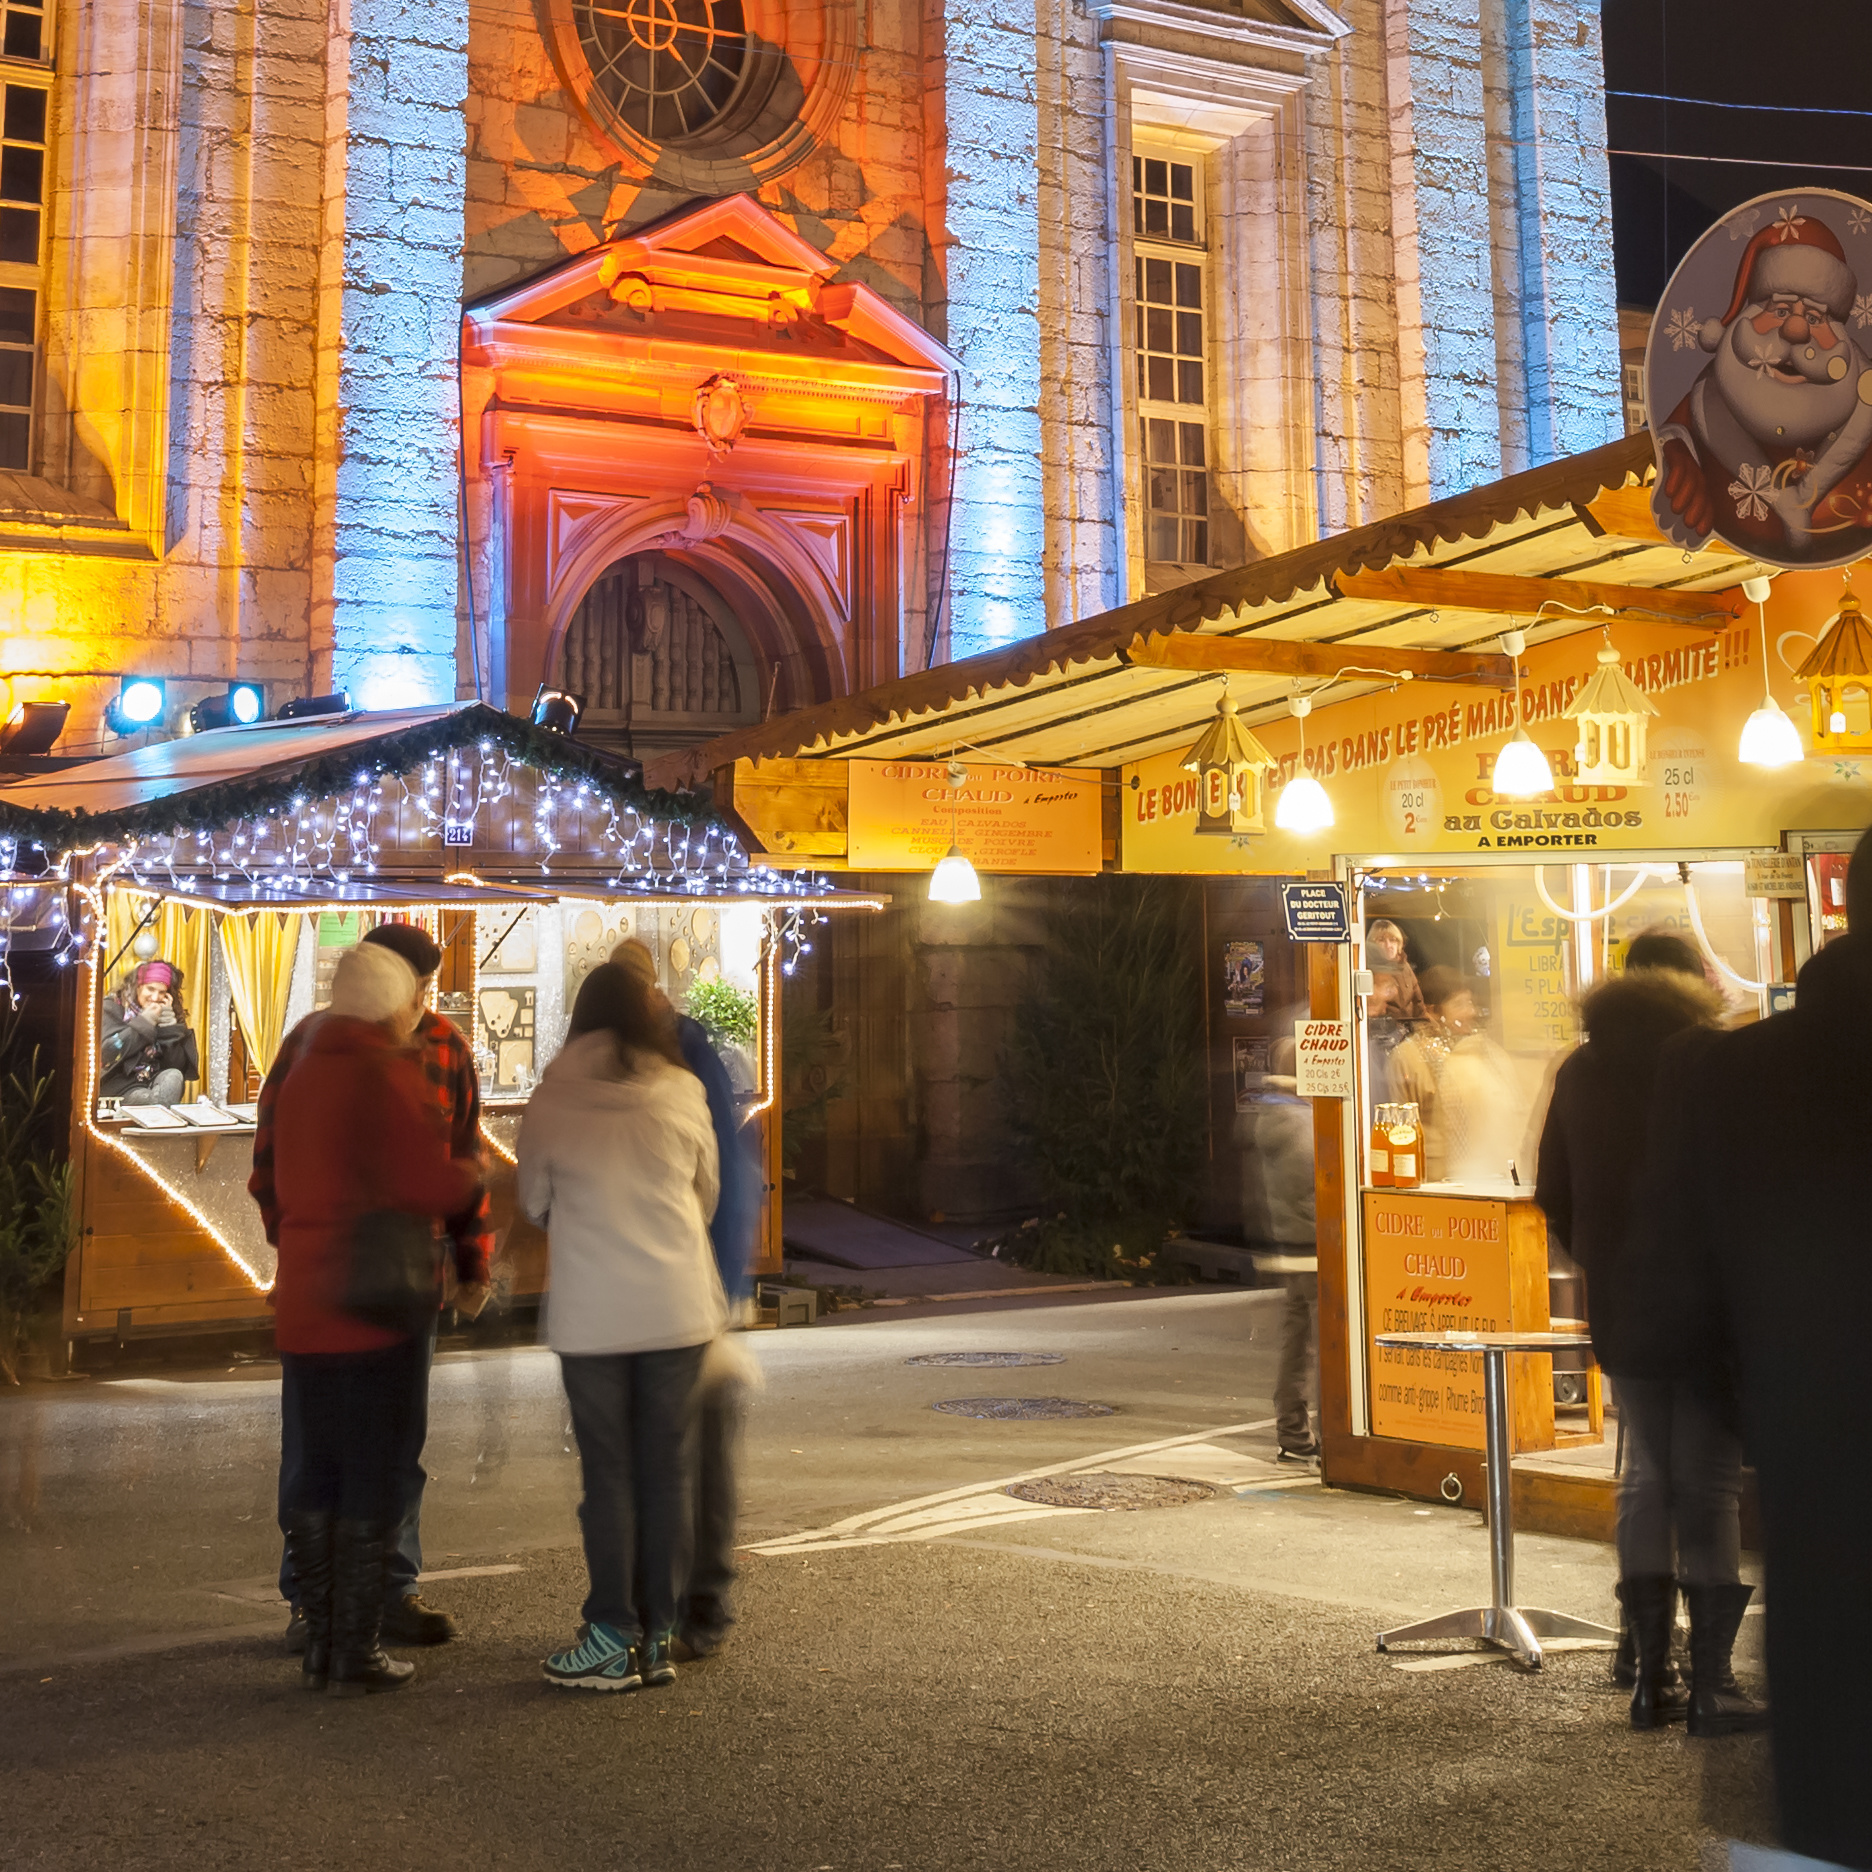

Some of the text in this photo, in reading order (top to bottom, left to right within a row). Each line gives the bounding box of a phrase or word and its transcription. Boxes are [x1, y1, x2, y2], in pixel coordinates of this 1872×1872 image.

[1137, 788, 1159, 824] LE
[1342, 726, 1392, 772] DANS
[1395, 717, 1421, 757] LE
[1423, 700, 1463, 750] PRÉ
[1466, 691, 1518, 740] MAIS
[1522, 678, 1579, 726] DANS
[1665, 766, 1694, 785] 25 cl
[921, 788, 1015, 805] CHAUD
[1402, 792, 1424, 808] 20 cl
[933, 805, 1002, 816] Composition
[920, 818, 1027, 829] EAU CALVADOS
[1404, 812, 1416, 834] 2
[449, 828, 469, 842] 214
[891, 827, 1053, 839] CANNELLE GINGEMBRE
[983, 838, 1036, 848] POIVRE
[1478, 834, 1597, 847] A EMPORTER
[1301, 889, 1326, 898] PLACE
[1290, 900, 1339, 909] DU DOCTEUR
[1305, 1024, 1343, 1036] CIDRE
[1300, 1039, 1349, 1051] CHAUD
[1375, 1211, 1426, 1237] CIDRE
[1404, 1253, 1467, 1279] CHAUD
